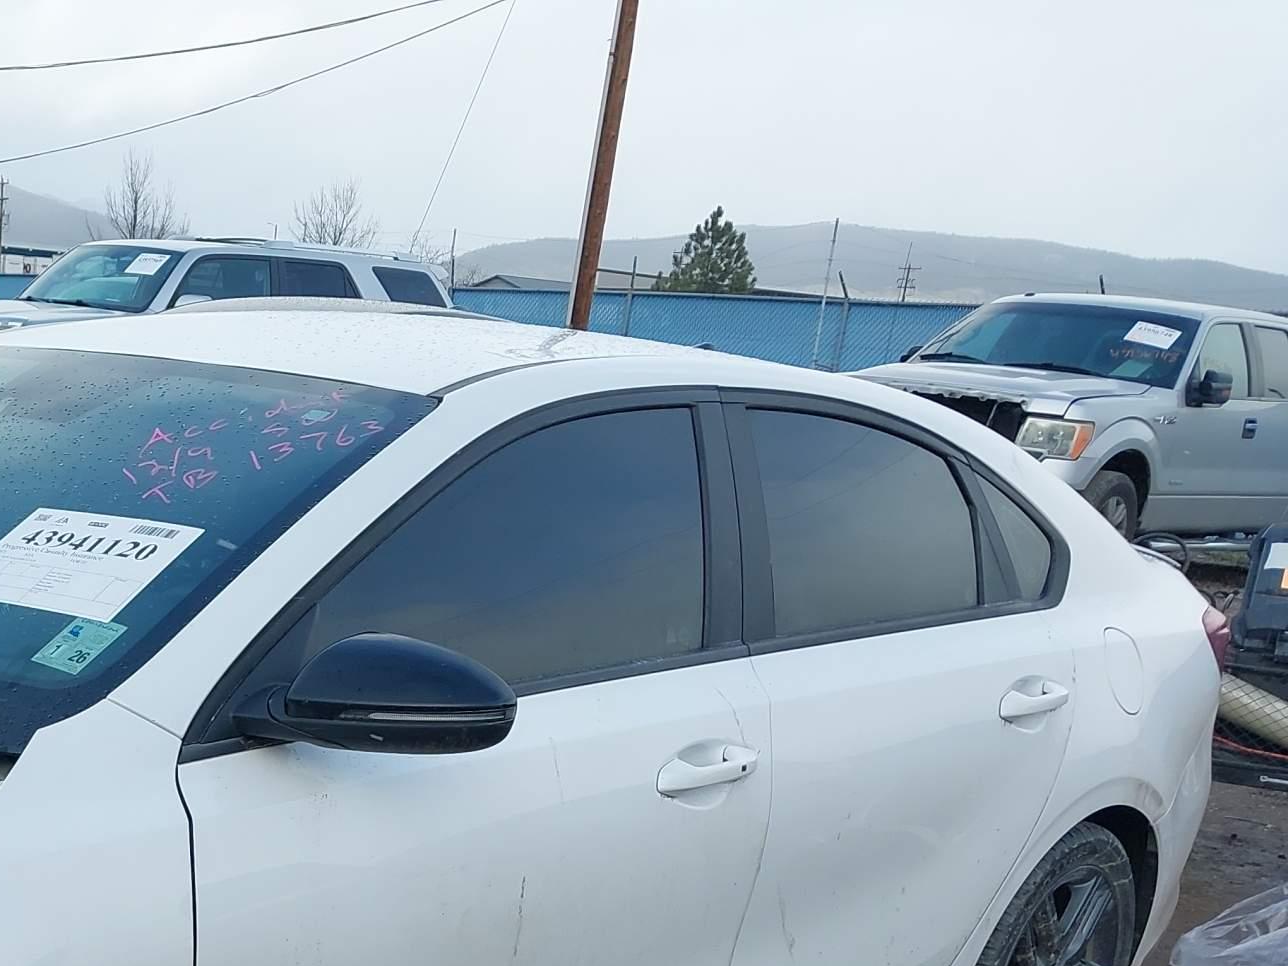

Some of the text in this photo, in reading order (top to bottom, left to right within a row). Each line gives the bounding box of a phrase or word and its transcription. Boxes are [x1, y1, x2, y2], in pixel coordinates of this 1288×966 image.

[20, 528, 159, 561] 43941120
[50, 643, 91, 664] 1 26
